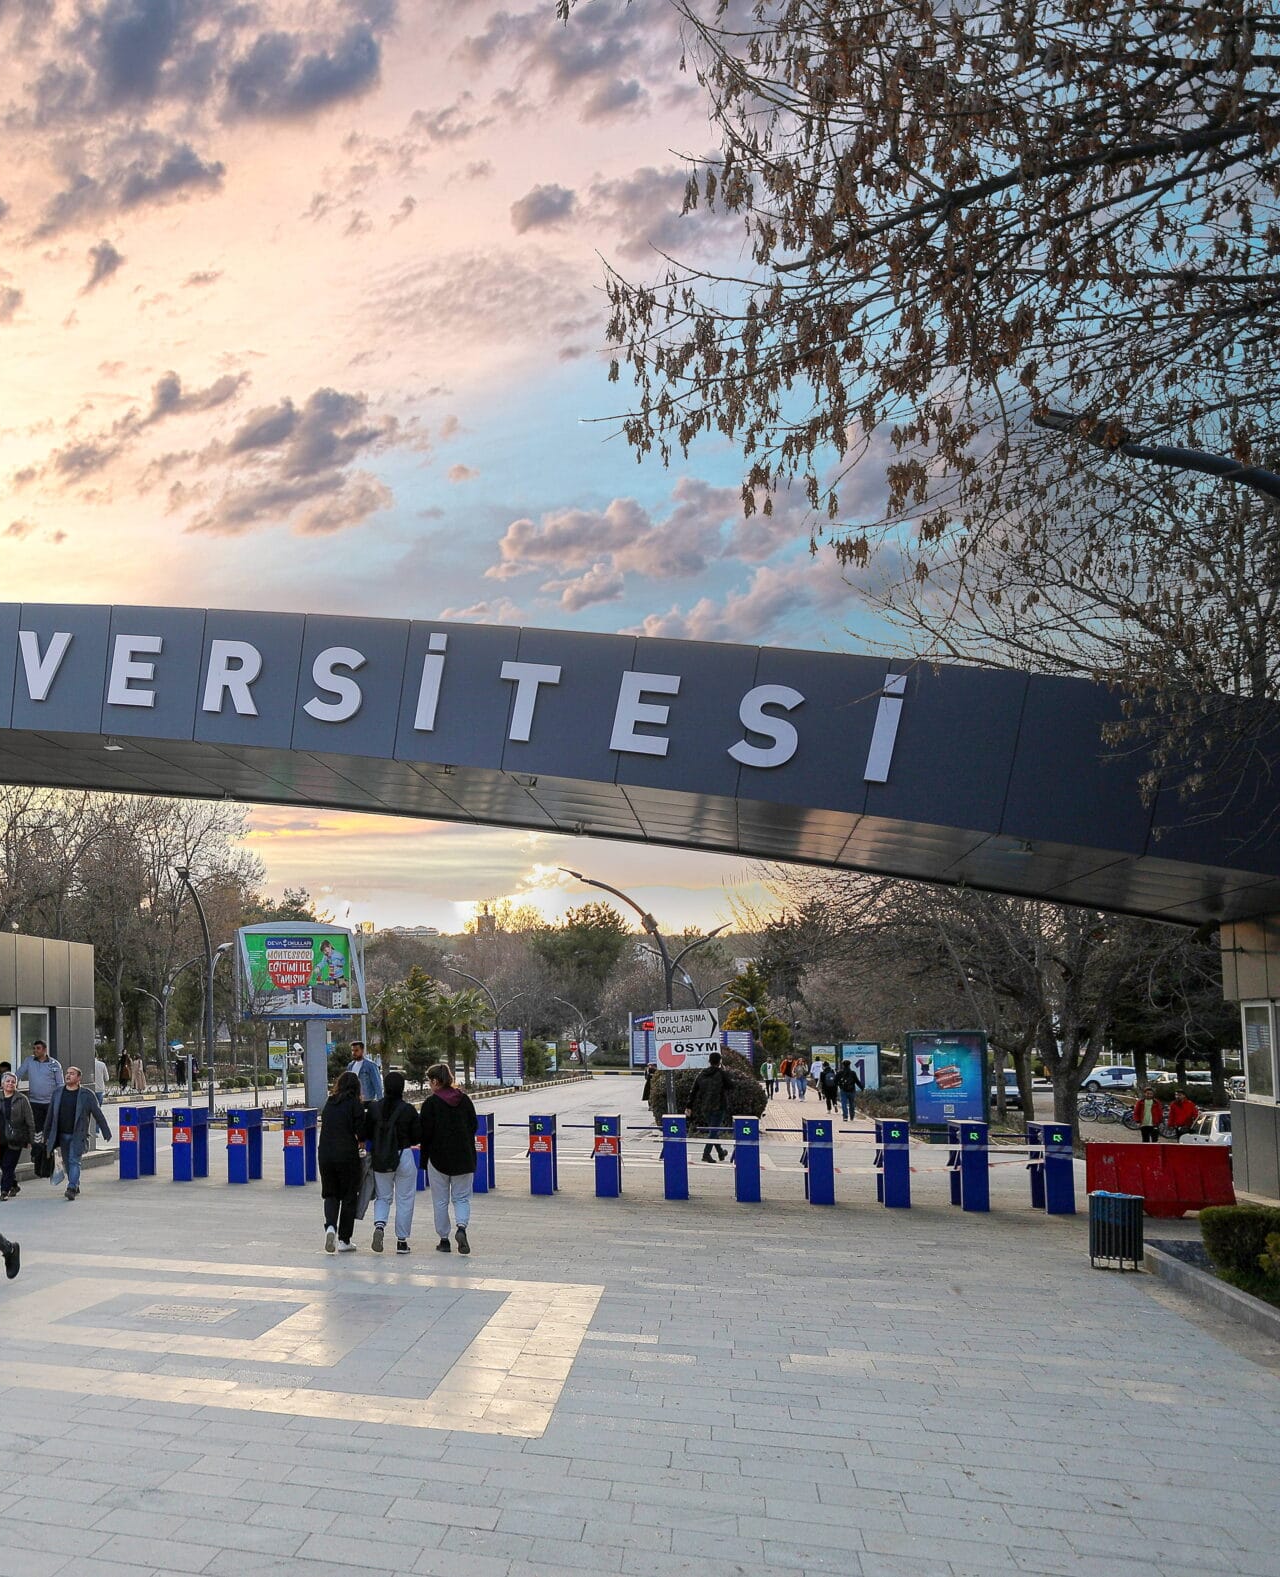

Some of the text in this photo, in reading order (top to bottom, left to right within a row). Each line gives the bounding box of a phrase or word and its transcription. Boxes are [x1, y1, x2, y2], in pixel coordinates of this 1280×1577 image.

[656, 1016, 679, 1024] TOPLU
[680, 1014, 706, 1023] TAŞIMA
[657, 1025, 693, 1035] ARAÇLARI
[674, 1041, 717, 1053] ÖSYM
